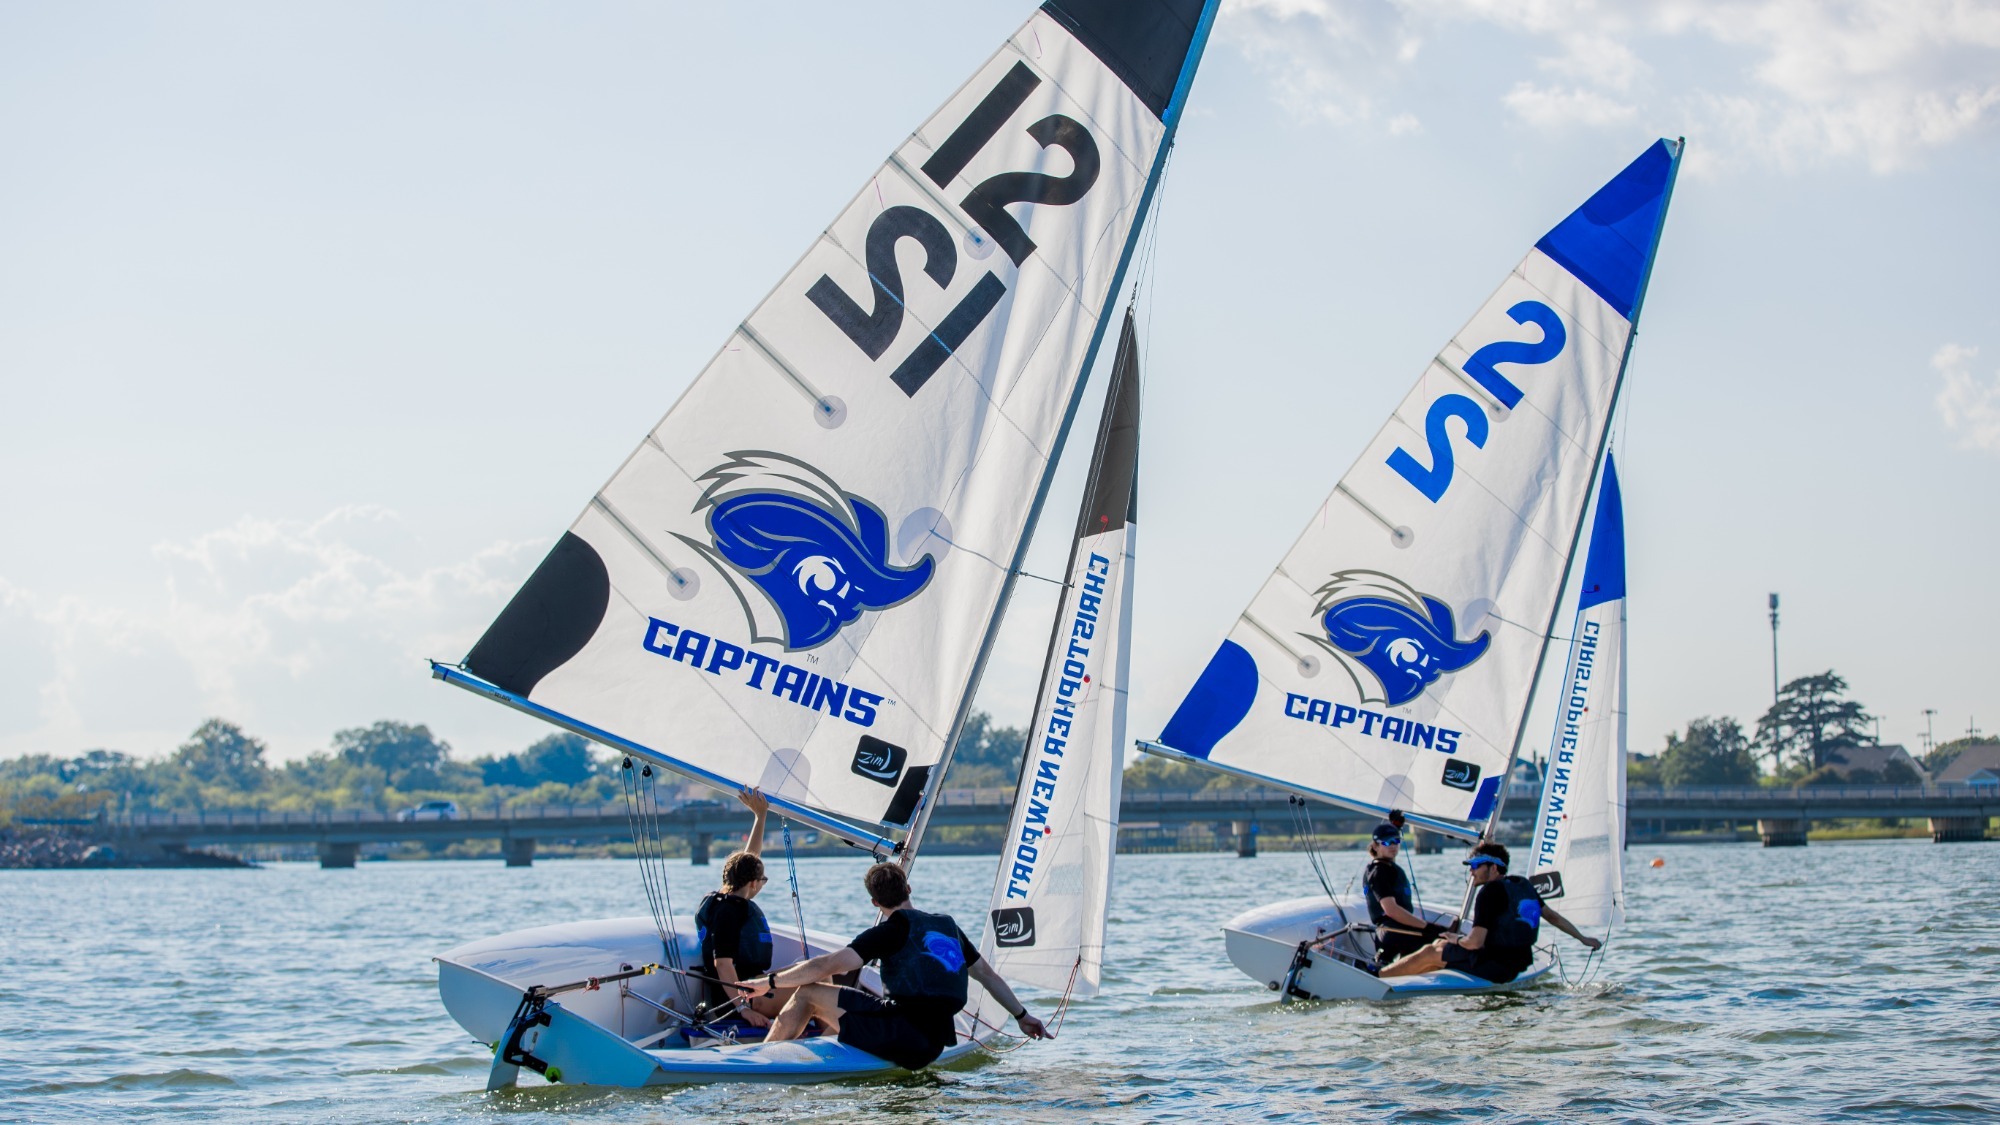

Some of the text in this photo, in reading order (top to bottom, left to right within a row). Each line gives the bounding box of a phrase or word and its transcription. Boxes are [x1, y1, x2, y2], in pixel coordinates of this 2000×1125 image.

[920, 60, 1101, 269] 12
[1461, 300, 1567, 411] 2
[642, 616, 885, 728] CAPTAINS
[806, 653, 819, 665] TM
[1284, 691, 1462, 755] CAPTAINS
